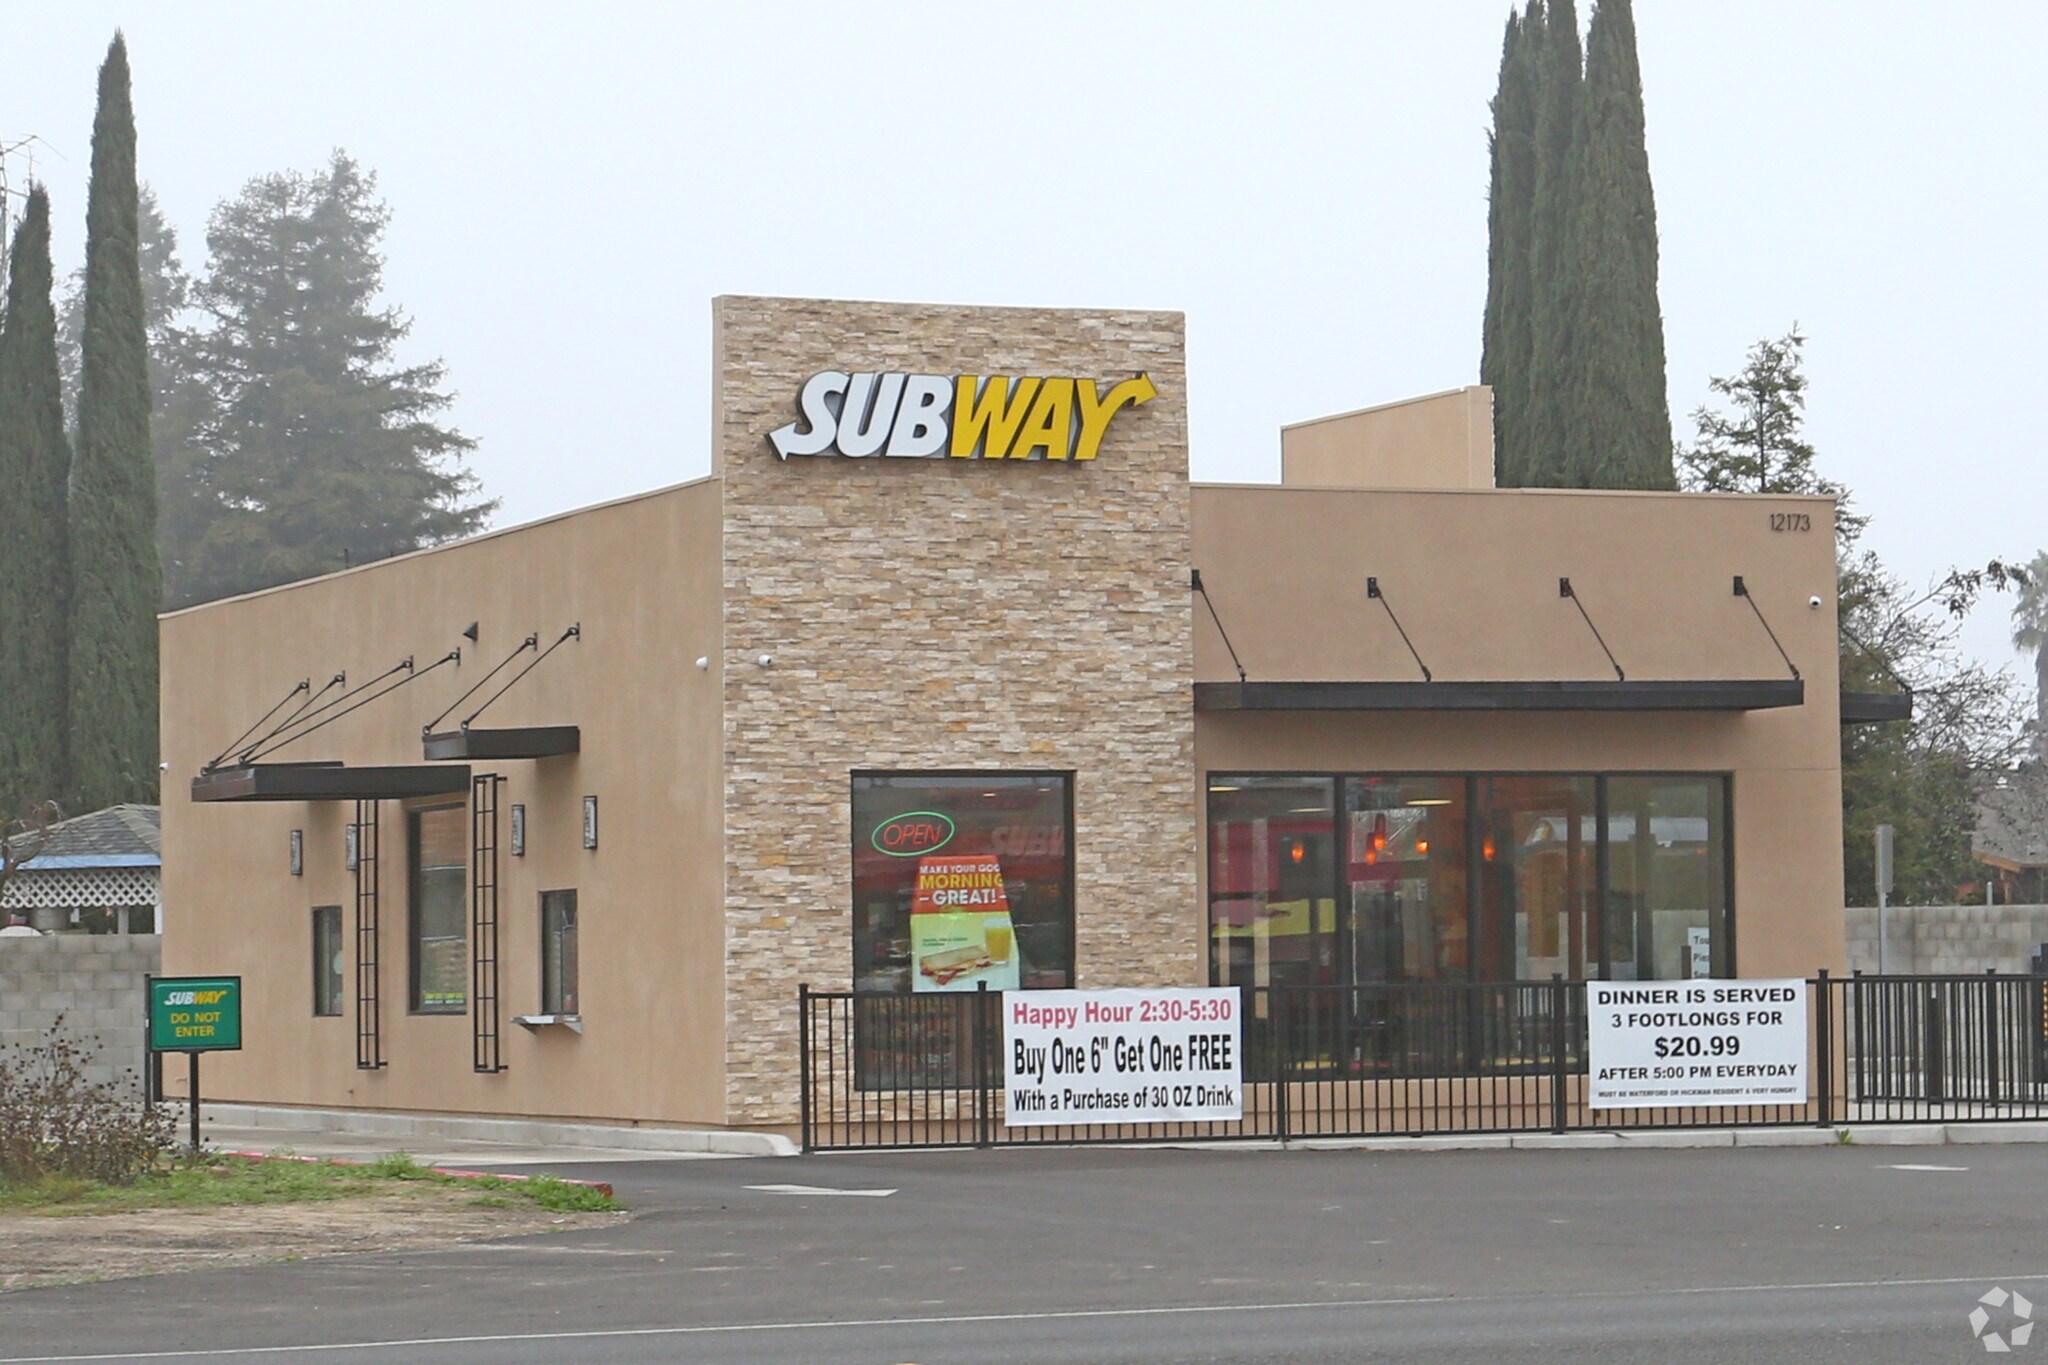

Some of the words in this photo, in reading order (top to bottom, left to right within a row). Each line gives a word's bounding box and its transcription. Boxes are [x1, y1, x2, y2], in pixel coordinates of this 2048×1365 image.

[766, 370, 1159, 461] SUBWAY
[1770, 512, 1811, 532] 12173
[883, 823, 942, 846] OPEN
[919, 865, 948, 874] MAKE
[950, 864, 976, 873] YOUR
[164, 990, 227, 1006] SUBWAY
[1598, 989, 1679, 1005] DINNER
[1687, 989, 1706, 1003] IS
[1713, 988, 1796, 1003] SERVED
[170, 1012, 190, 1024] DO
[195, 1011, 221, 1023] NOT
[1013, 1002, 1078, 1029] Happy
[1085, 1001, 1133, 1023] Hour
[1140, 998, 1232, 1022] 2:30-5:30
[1611, 1013, 1622, 1028] 3
[1628, 1011, 1741, 1028] FOOTLONGS
[1747, 1011, 1783, 1026] FOR
[175, 1025, 215, 1038] ENTER
[1654, 1035, 1740, 1060] $20.99
[1014, 1038, 1046, 1084] Buy
[1052, 1036, 1085, 1074] One
[1091, 1036, 1108, 1073] 6"
[1114, 1035, 1145, 1073] Get
[1150, 1034, 1183, 1072] One
[1188, 1033, 1232, 1071] FREE
[1598, 1067, 1648, 1081] AFTER
[1653, 1066, 1685, 1080] 5:00
[1689, 1065, 1712, 1079] PM
[1717, 1064, 1798, 1078] EVERYDAY
[1013, 1088, 1046, 1111] With
[1050, 1093, 1059, 1110] a
[1064, 1087, 1129, 1110] Purchase
[1135, 1086, 1148, 1108] of
[1152, 1086, 1168, 1108] 30
[1173, 1085, 1192, 1107] OZ
[1197, 1084, 1234, 1107] Drink
